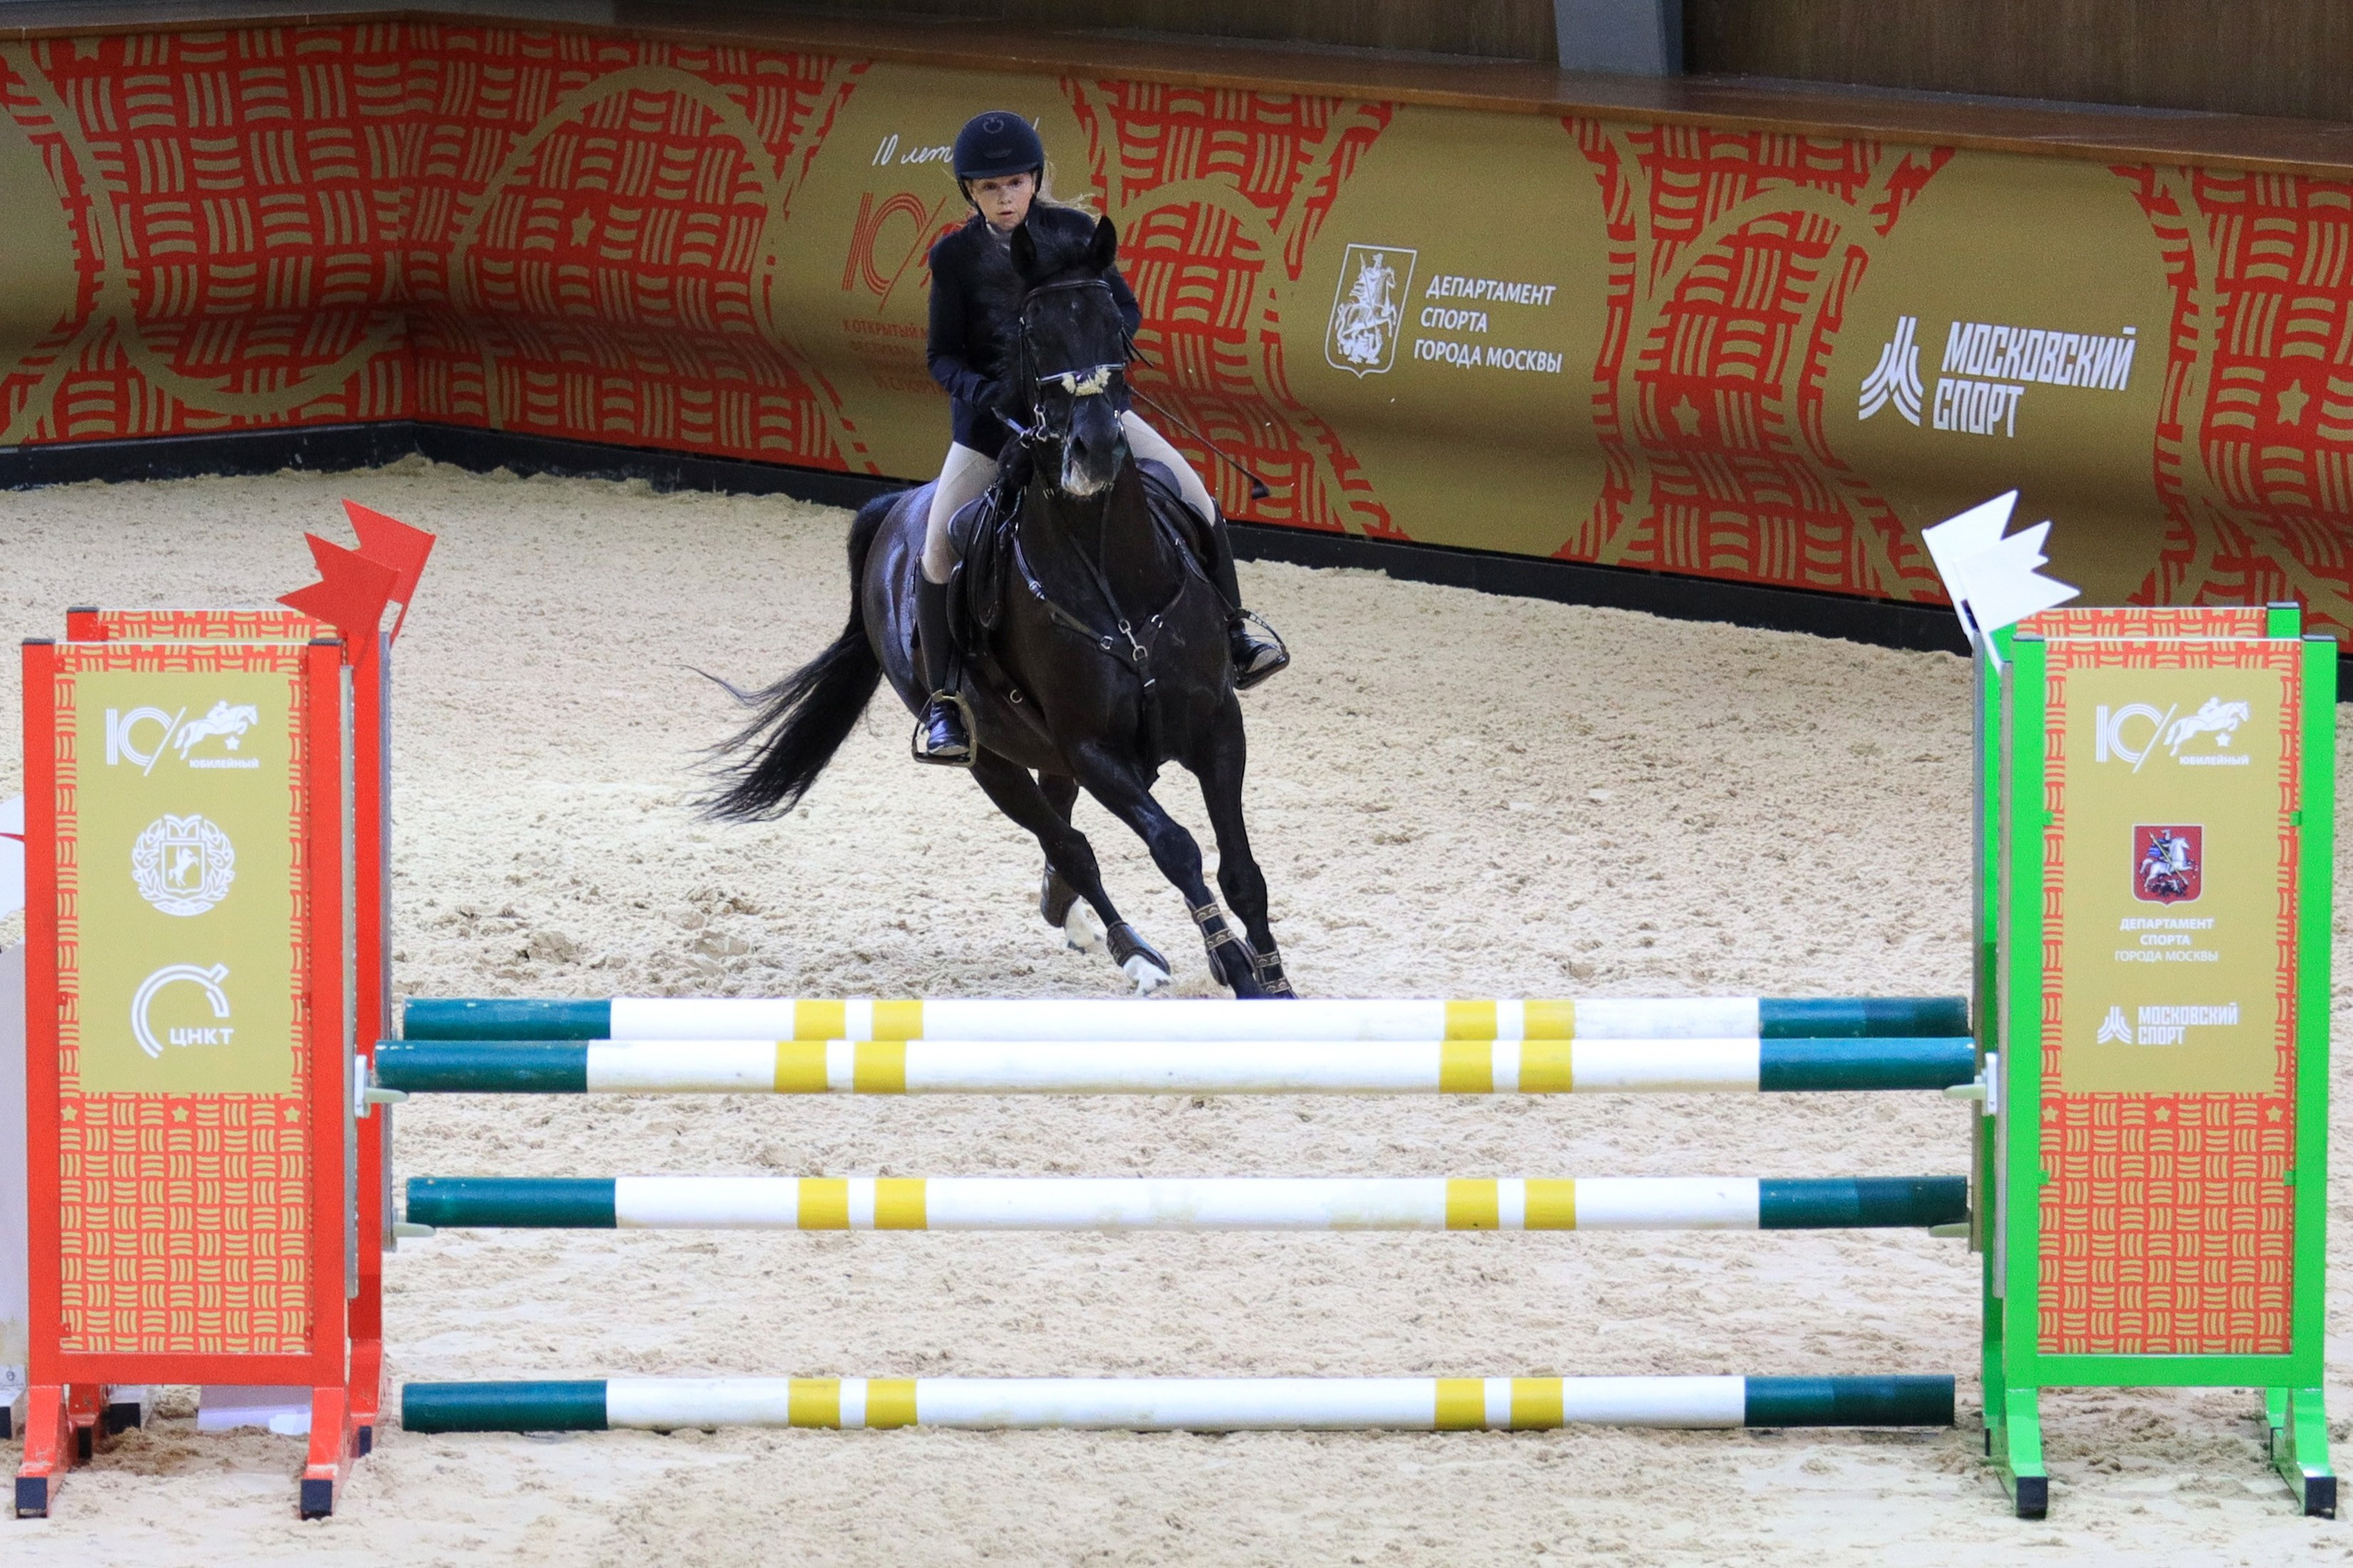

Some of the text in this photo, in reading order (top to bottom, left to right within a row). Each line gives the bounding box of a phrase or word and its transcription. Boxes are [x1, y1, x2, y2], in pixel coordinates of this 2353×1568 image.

[871, 133, 899, 166] 10
[1426, 275, 1557, 306] ДЕПАРТАМЕНТ
[851, 319, 918, 340] ОТКРЫТЫЙ
[1420, 307, 1488, 334] СПОРТА
[1414, 338, 1563, 374] ГОРОДА МОСКВЫ
[1940, 321, 2137, 392] МОСКОВСКИЙ
[1933, 377, 2026, 438] СПОРТ
[188, 757, 259, 768] ЮБИЛЕЙНЫЙ
[2178, 755, 2250, 766] ЮБИЛЕЙНЫЙ
[2119, 917, 2215, 932] ДЕПАРТАМЕНТ
[2139, 934, 2192, 946] СПОРТА
[2114, 950, 2219, 963] ГОРОДА МОСКВЫ
[2137, 1002, 2239, 1026] МОСКОВСКИЙ
[169, 1027, 235, 1048] ЦНКТ
[2137, 1026, 2186, 1045] СПОРТ
